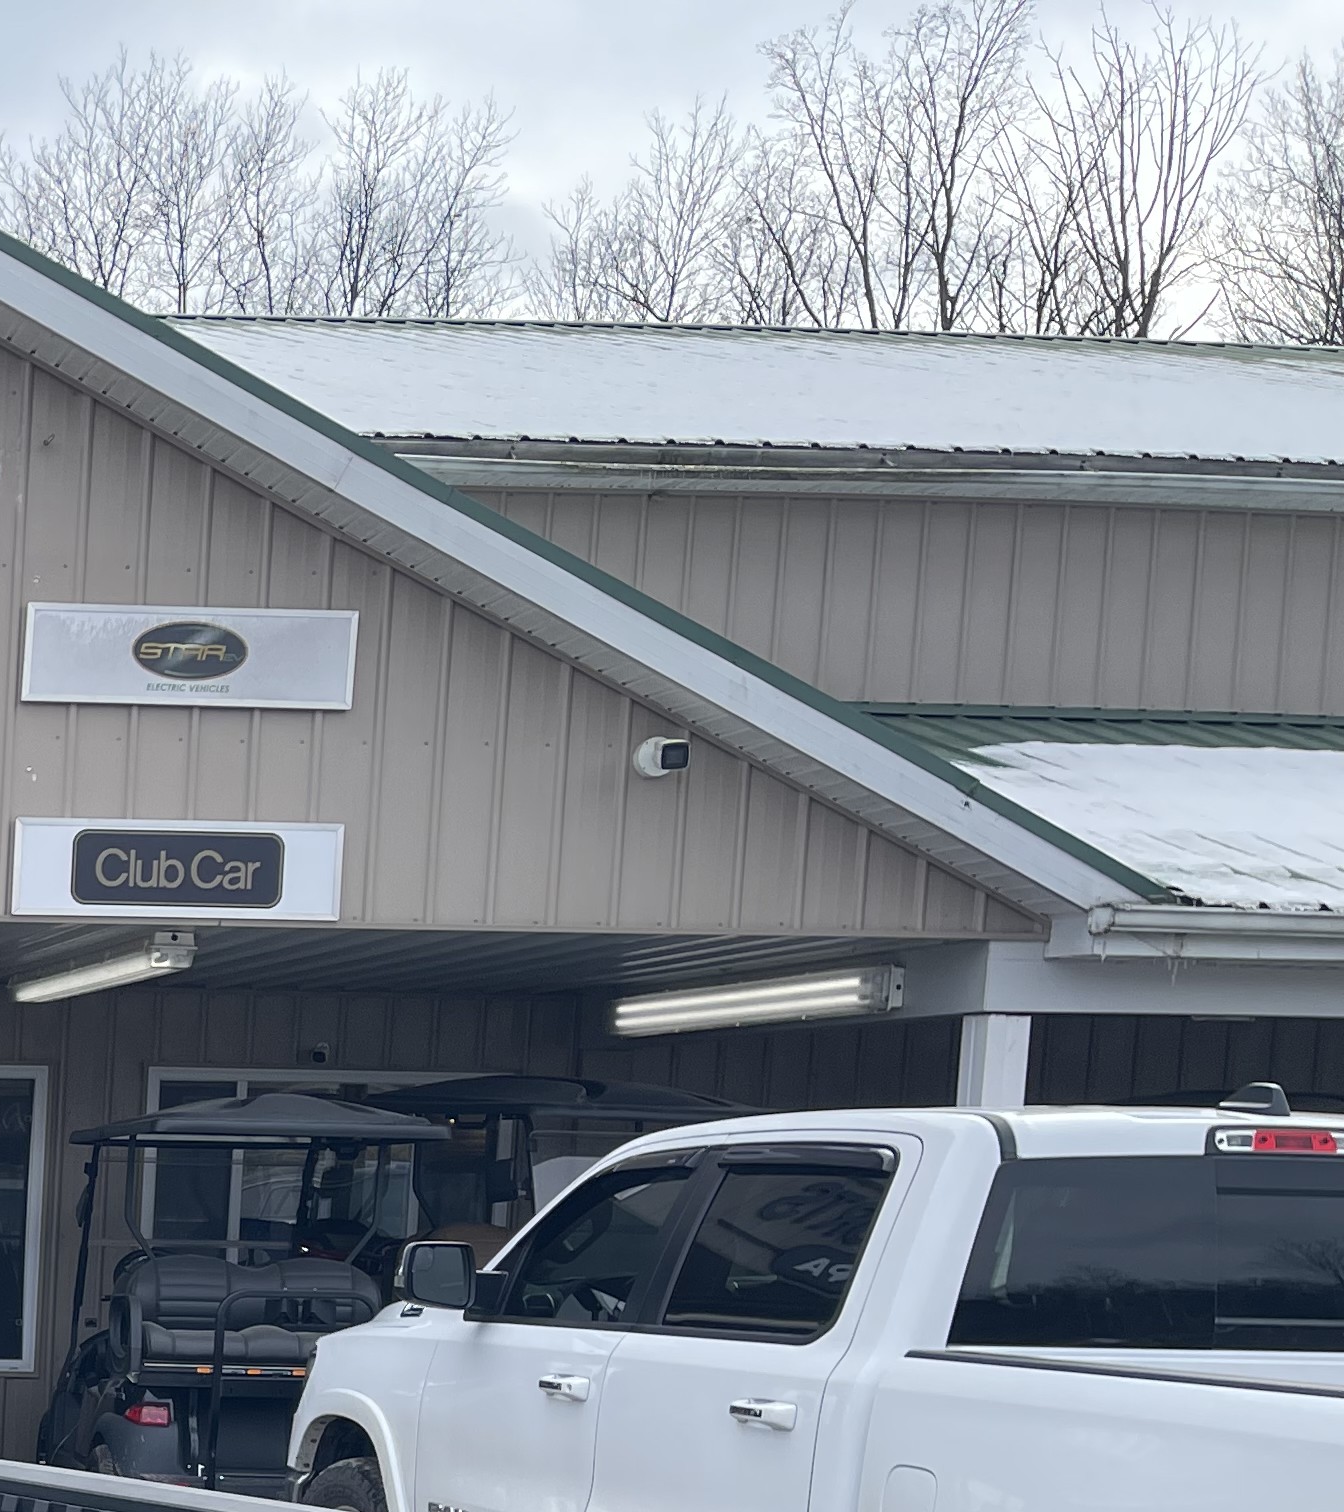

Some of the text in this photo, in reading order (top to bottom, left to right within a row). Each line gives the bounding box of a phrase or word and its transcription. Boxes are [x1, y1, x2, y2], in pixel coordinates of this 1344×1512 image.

[138, 642, 227, 662] STAR
[146, 682, 230, 694] ELECTRIC VEHICLES
[95, 847, 261, 890] Club Car
